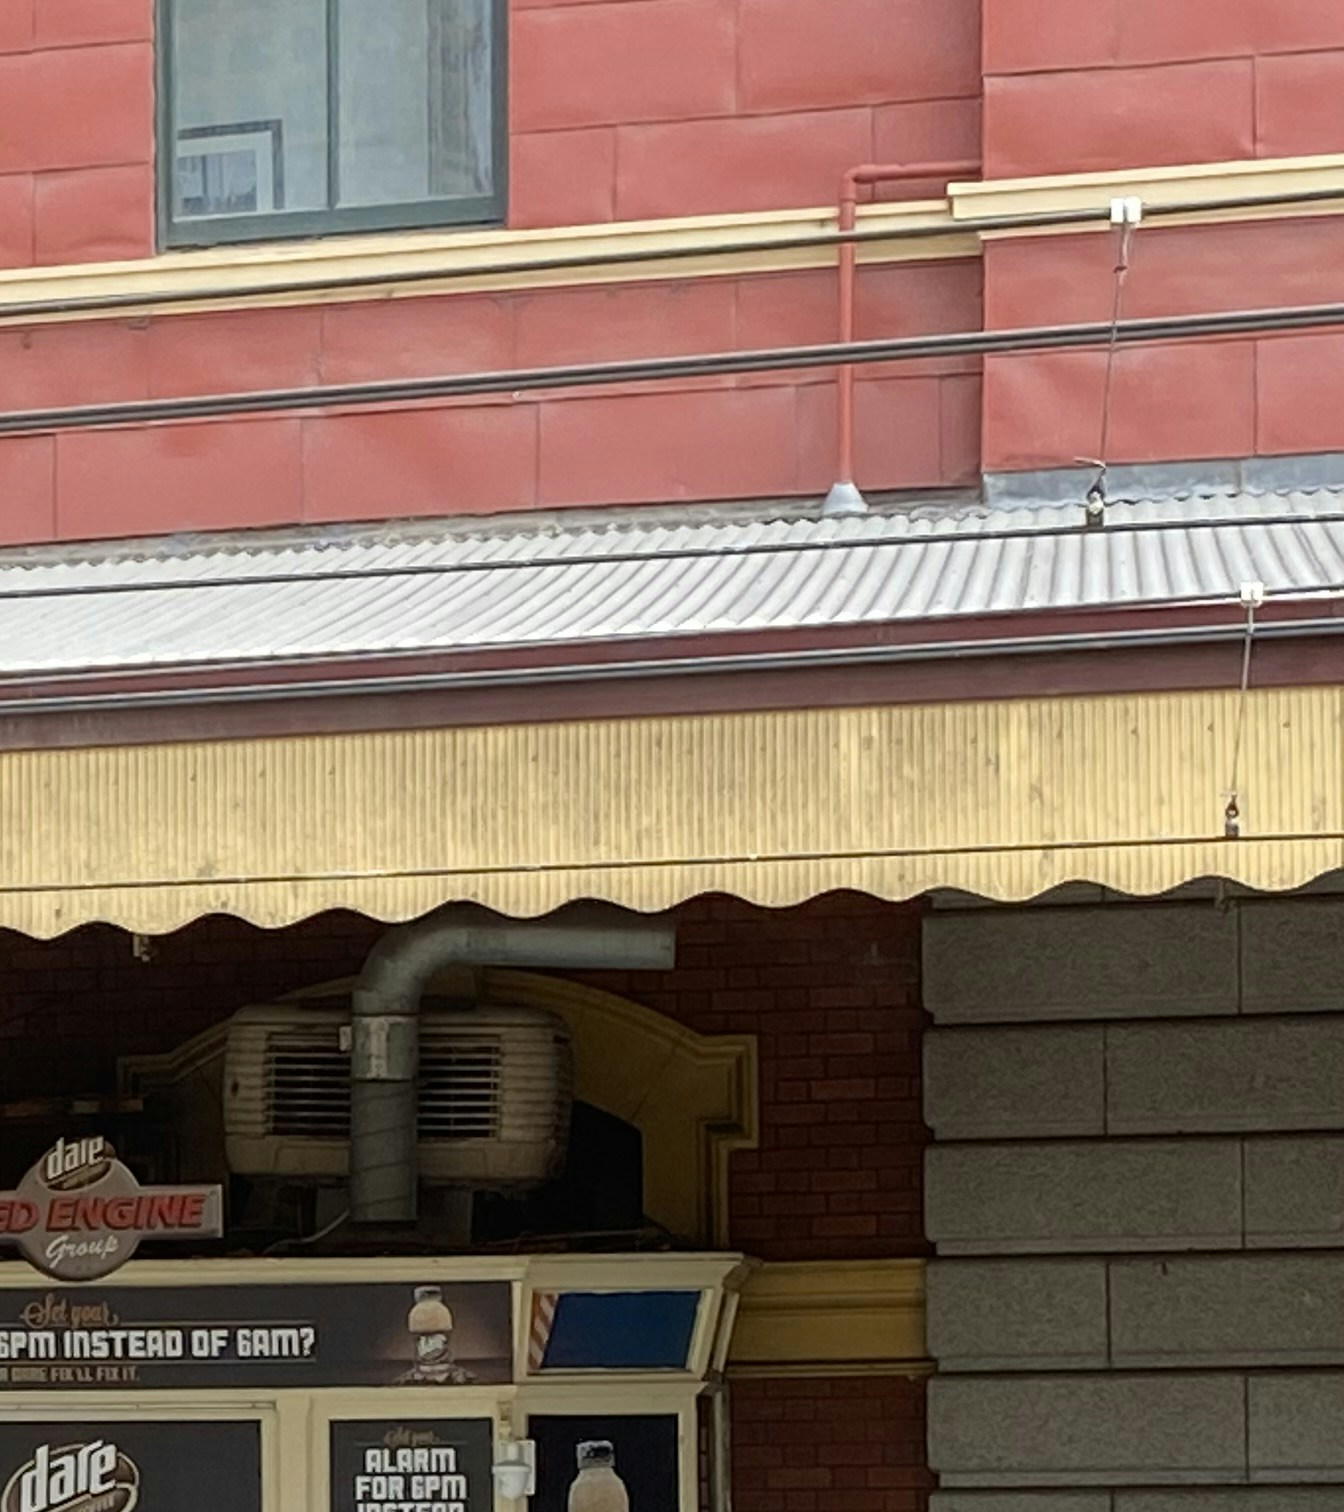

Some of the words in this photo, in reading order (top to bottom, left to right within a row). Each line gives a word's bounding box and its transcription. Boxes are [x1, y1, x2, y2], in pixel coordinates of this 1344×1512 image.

[47, 1136, 104, 1180] dare
[46, 1195, 206, 1232] ENGINE
[45, 1234, 120, 1268] Group
[64, 1329, 183, 1358] INSTEAD
[191, 1328, 229, 1358] OF
[236, 1327, 316, 1357] 6AM?
[365, 1448, 457, 1473] ALARM
[355, 1475, 405, 1500] FOR
[411, 1475, 468, 1500] 6PM
